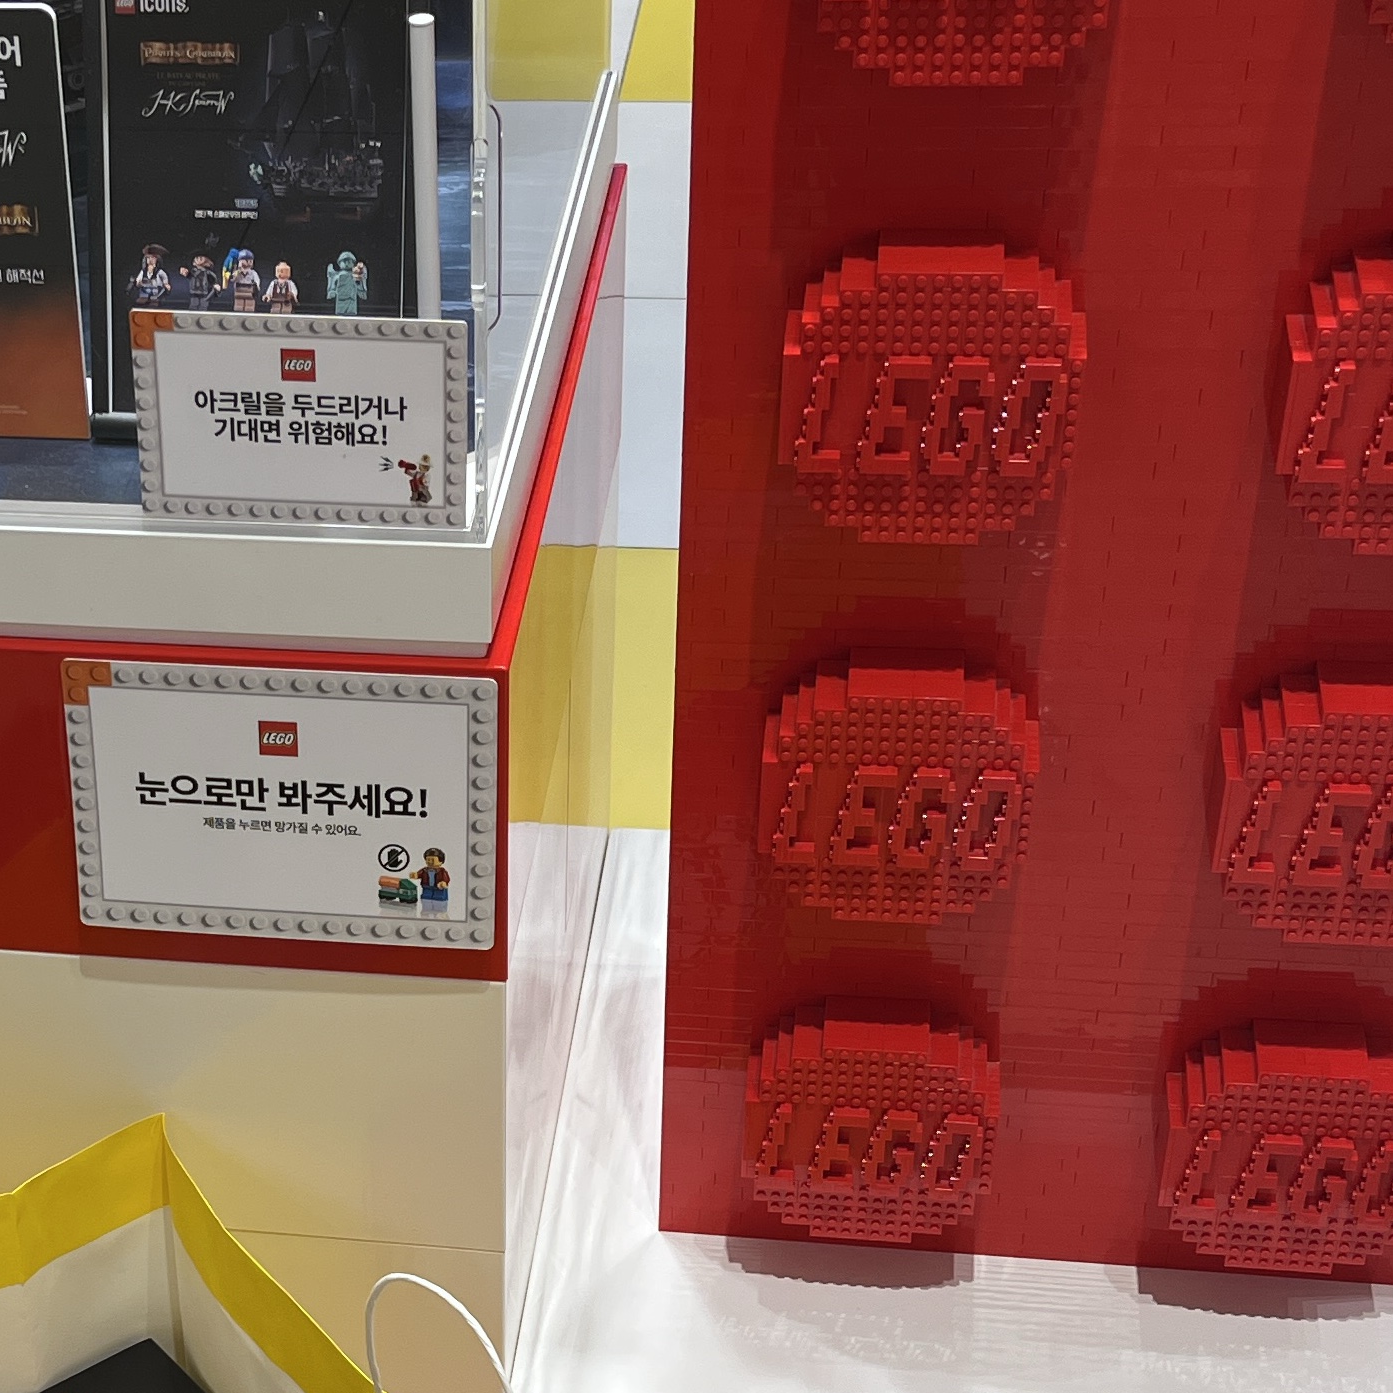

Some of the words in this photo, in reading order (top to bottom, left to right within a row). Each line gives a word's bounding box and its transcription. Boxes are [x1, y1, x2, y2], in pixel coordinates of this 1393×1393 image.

[6, 268, 45, 285] 해적선
[284, 359, 313, 372] LEGO
[194, 389, 286, 417] 아크릴을
[291, 394, 408, 421] 두드리거나
[793, 353, 1068, 477] LEGO
[214, 417, 282, 444] 기대면
[287, 420, 388, 447] 위험해요!
[261, 731, 296, 747] LEGO
[135, 771, 269, 812] 눈으로만
[277, 779, 429, 819] 봐주세요!
[203, 816, 236, 830] 제품을
[238, 818, 272, 832] 누르면
[274, 820, 308, 834] 망가질
[311, 823, 323, 835] 수
[770, 763, 1022, 871] LEGO
[754, 1101, 983, 1192] LEGO
